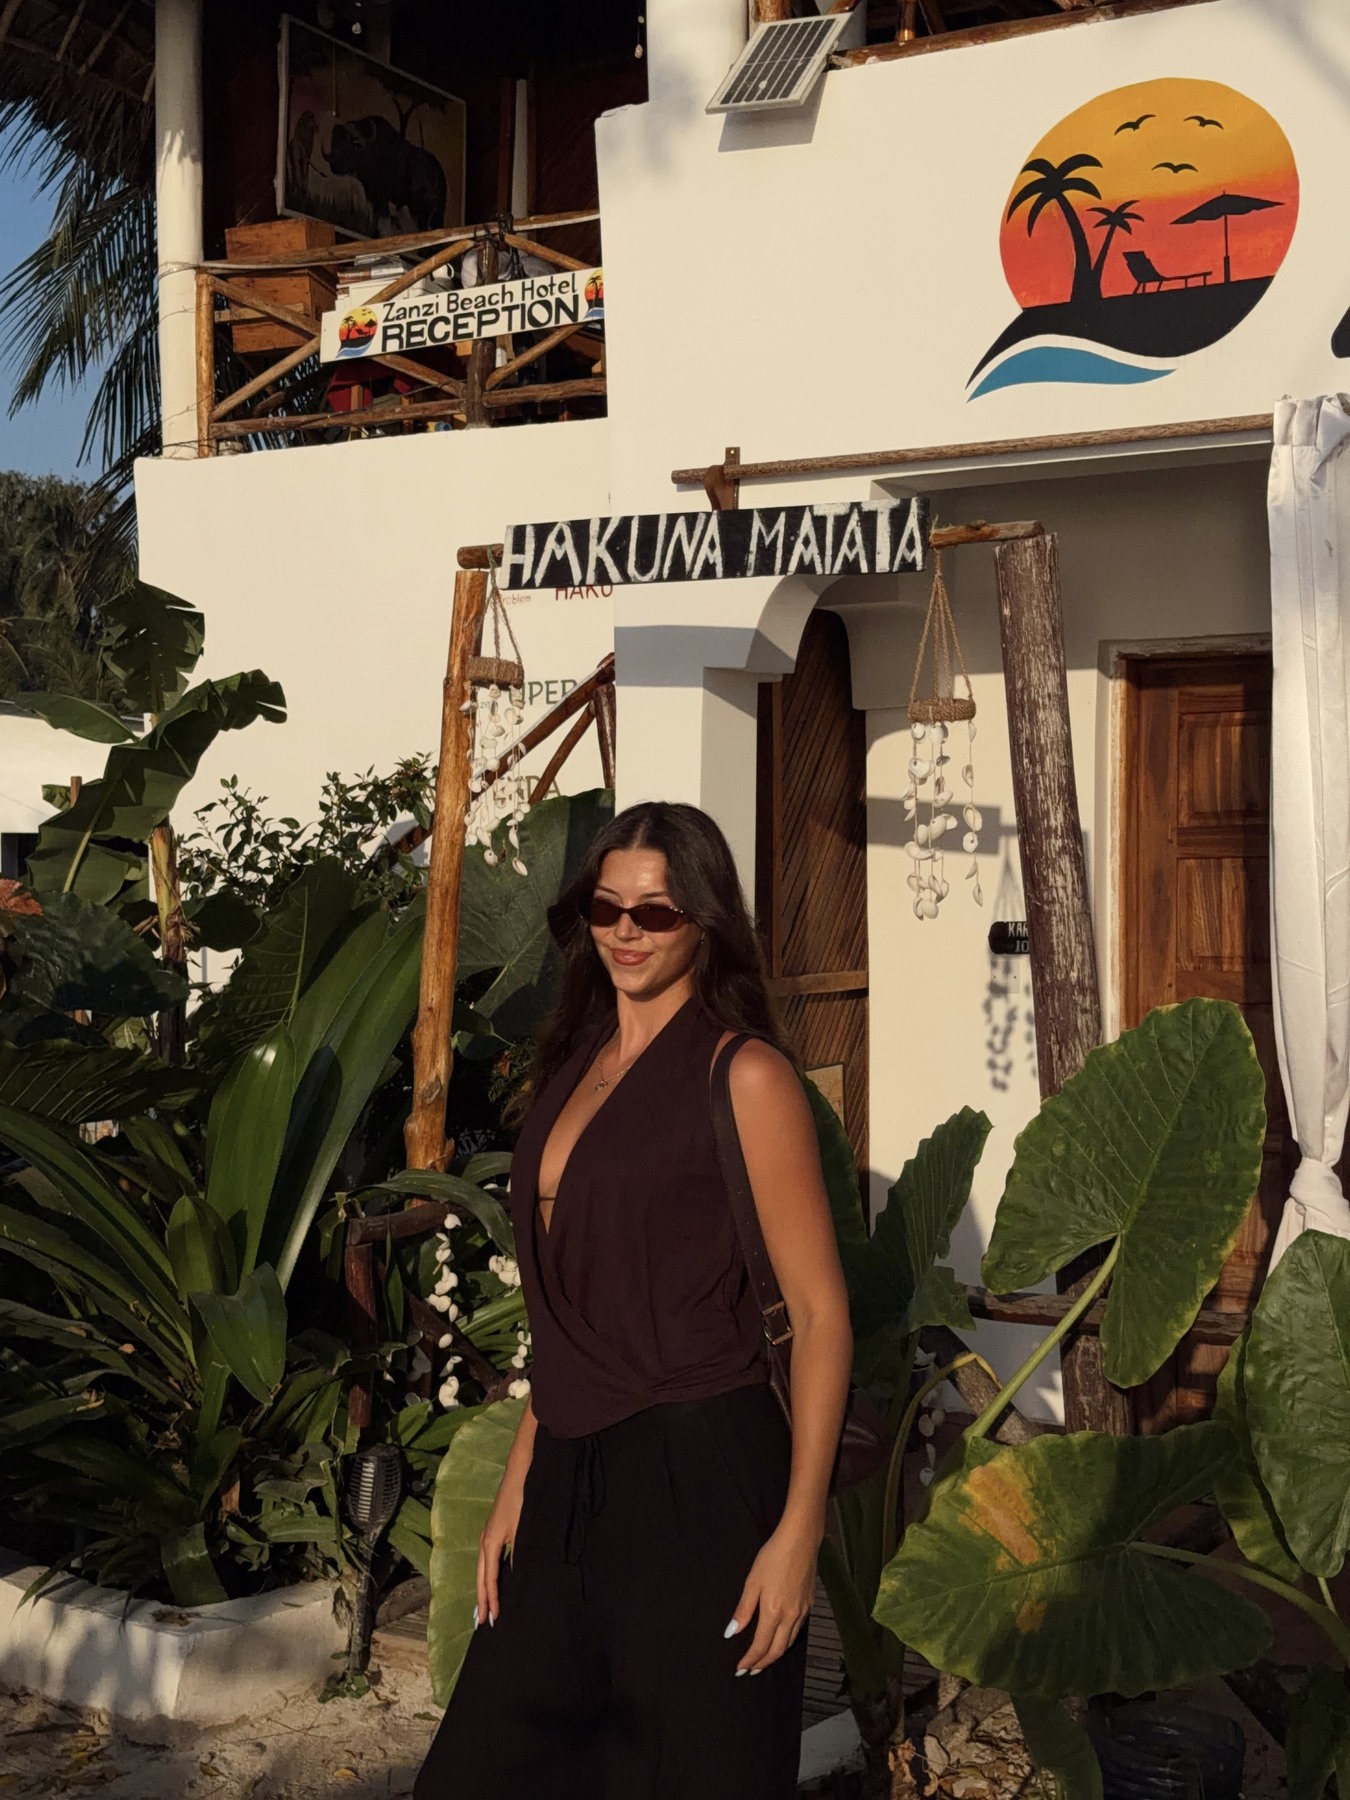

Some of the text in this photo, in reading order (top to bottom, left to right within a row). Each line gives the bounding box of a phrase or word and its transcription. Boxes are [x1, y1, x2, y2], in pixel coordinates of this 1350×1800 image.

[381, 293, 580, 353] RECEPTION
[382, 272, 578, 323] Zanzi Beach Hotel
[499, 496, 924, 589] HAKUNA MATATA
[497, 593, 532, 606] roblem
